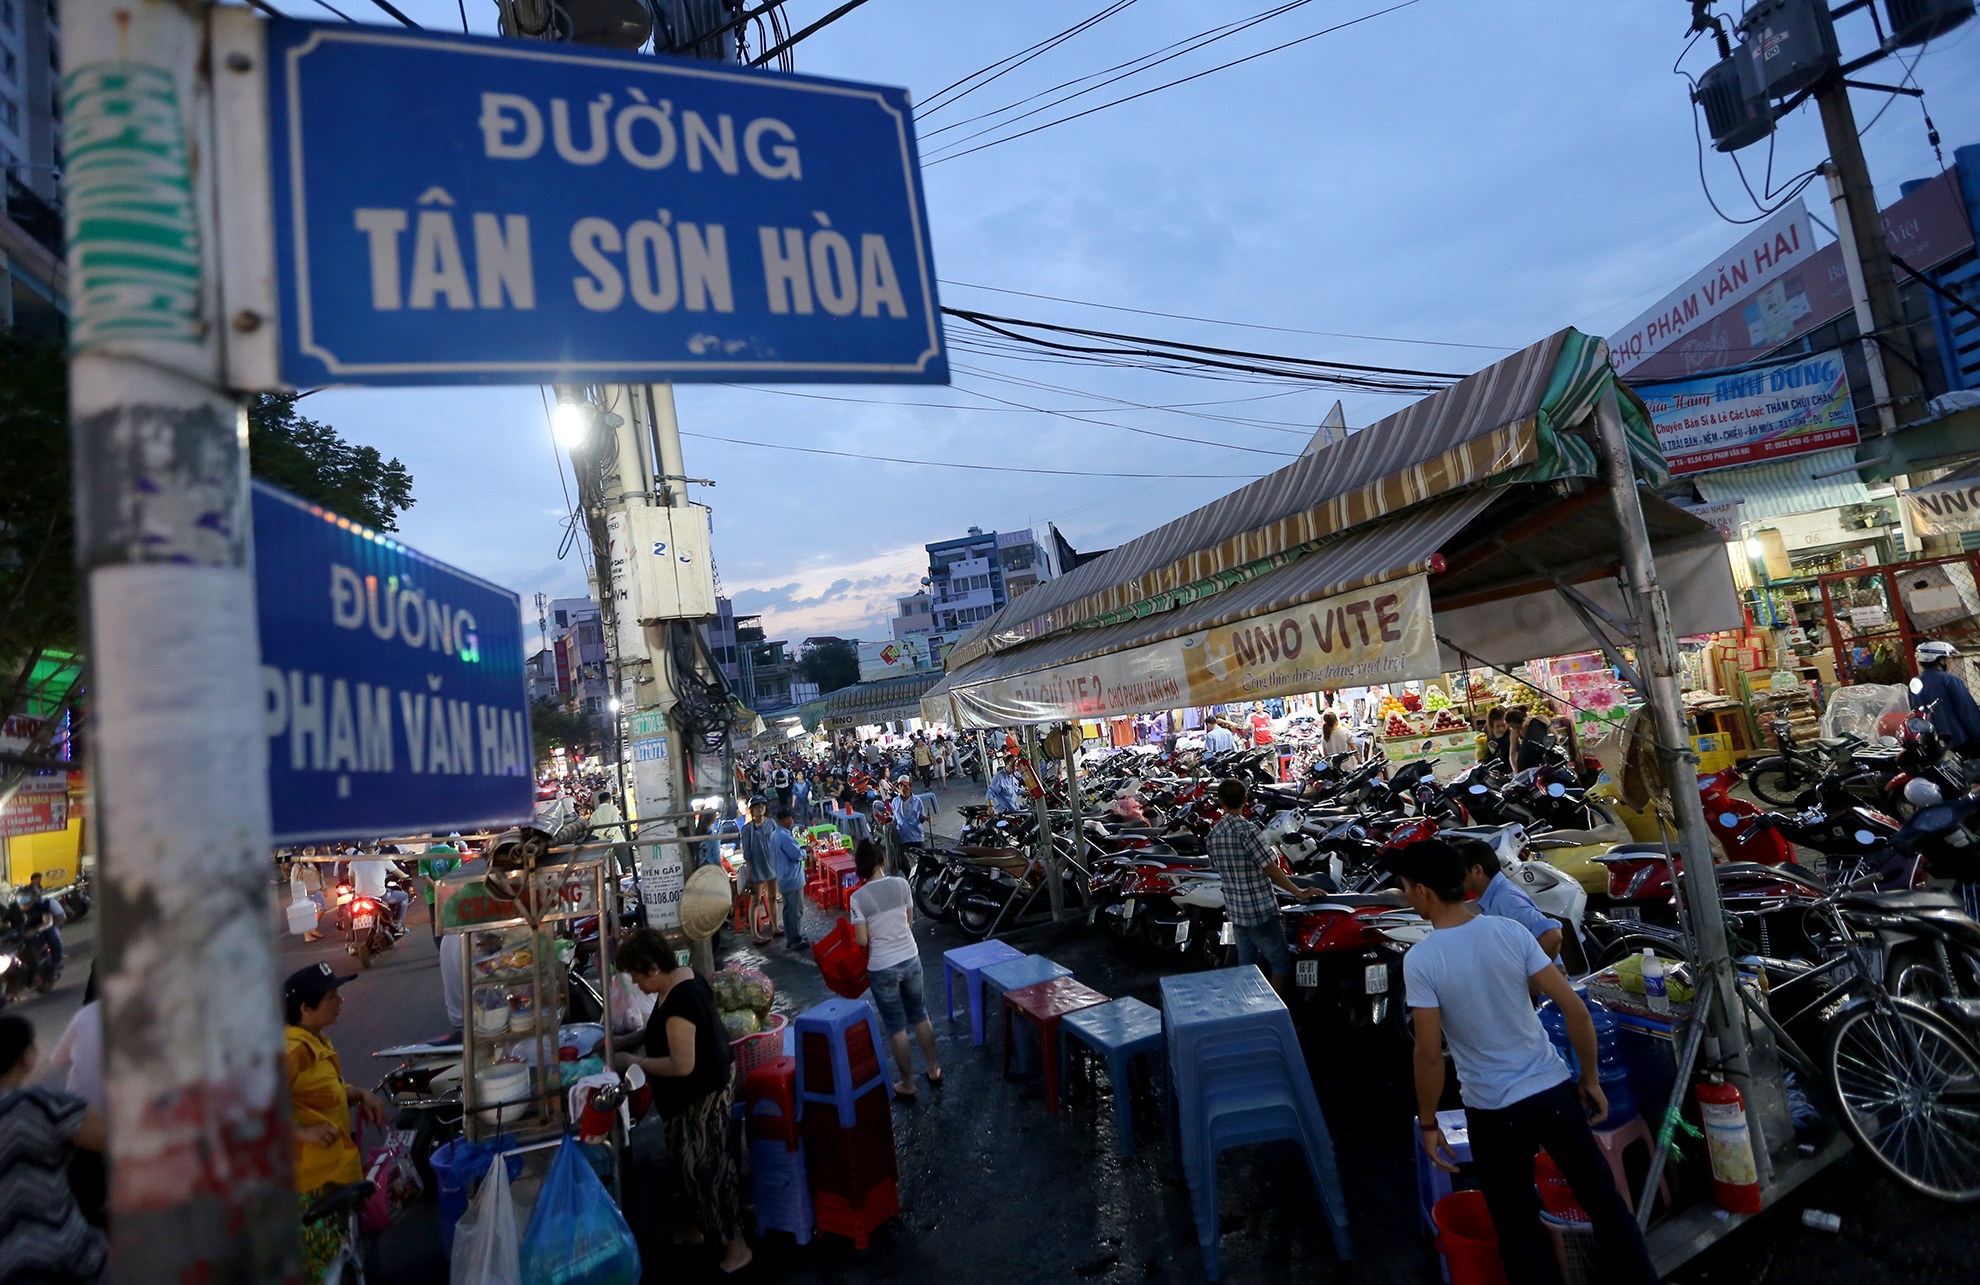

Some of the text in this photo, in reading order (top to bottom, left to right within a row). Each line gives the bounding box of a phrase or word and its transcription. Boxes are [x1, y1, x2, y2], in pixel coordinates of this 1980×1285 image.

[480, 88, 801, 181] ĐƯỜNG
[355, 187, 908, 319] TÂN SƠN HÒA
[1610, 223, 1800, 370] CHỢ PHẠM VĂN HAI
[1716, 371, 1764, 402] ANH
[1656, 421, 1683, 434] Chuyên
[1684, 417, 1699, 430] Bán
[1710, 415, 1716, 424] &
[1729, 410, 1744, 420] Các
[653, 542, 666, 556] 2
[997, 529, 1032, 546] HOTEL
[1805, 534, 1821, 545] 06
[330, 564, 480, 663] ĐƯỜNG
[1232, 593, 1401, 668] NNO VITE
[1067, 677, 1092, 712] XE
[1093, 675, 1106, 710] 2
[1107, 675, 1180, 712] CHỢ PHẠM VĂN HAI
[262, 664, 525, 798] PHẠM VĂN HAI
[832, 715, 853, 725] NNO
[662, 864, 681, 875] GẤP
